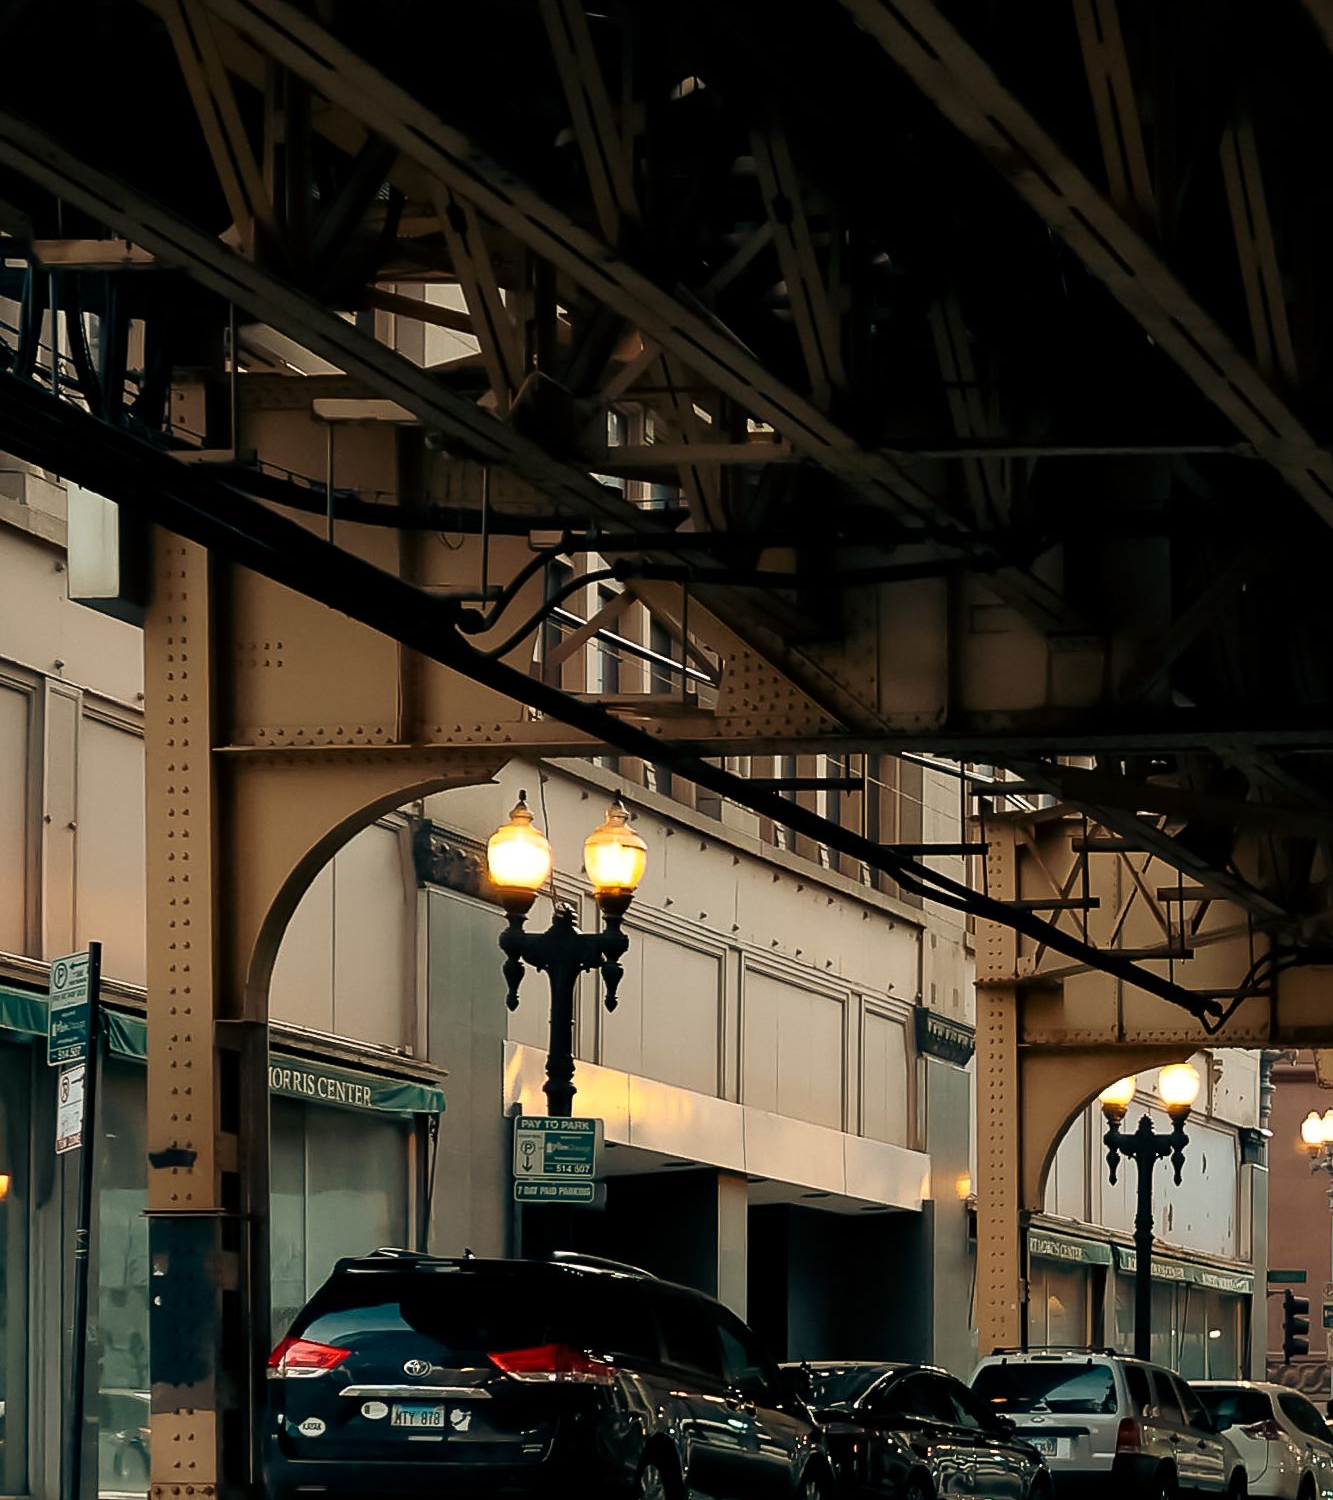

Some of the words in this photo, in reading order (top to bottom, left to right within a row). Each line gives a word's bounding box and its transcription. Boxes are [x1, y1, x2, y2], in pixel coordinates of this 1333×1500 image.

[317, 1077, 372, 1107] CENTER
[521, 1120, 541, 1129] PAY
[544, 1120, 558, 1129] TO
[561, 1121, 590, 1131] PARK
[556, 1164, 572, 1173] 514
[517, 1186, 523, 1195] 7
[539, 1187, 557, 1195] PAID
[558, 1187, 591, 1196] PARKING
